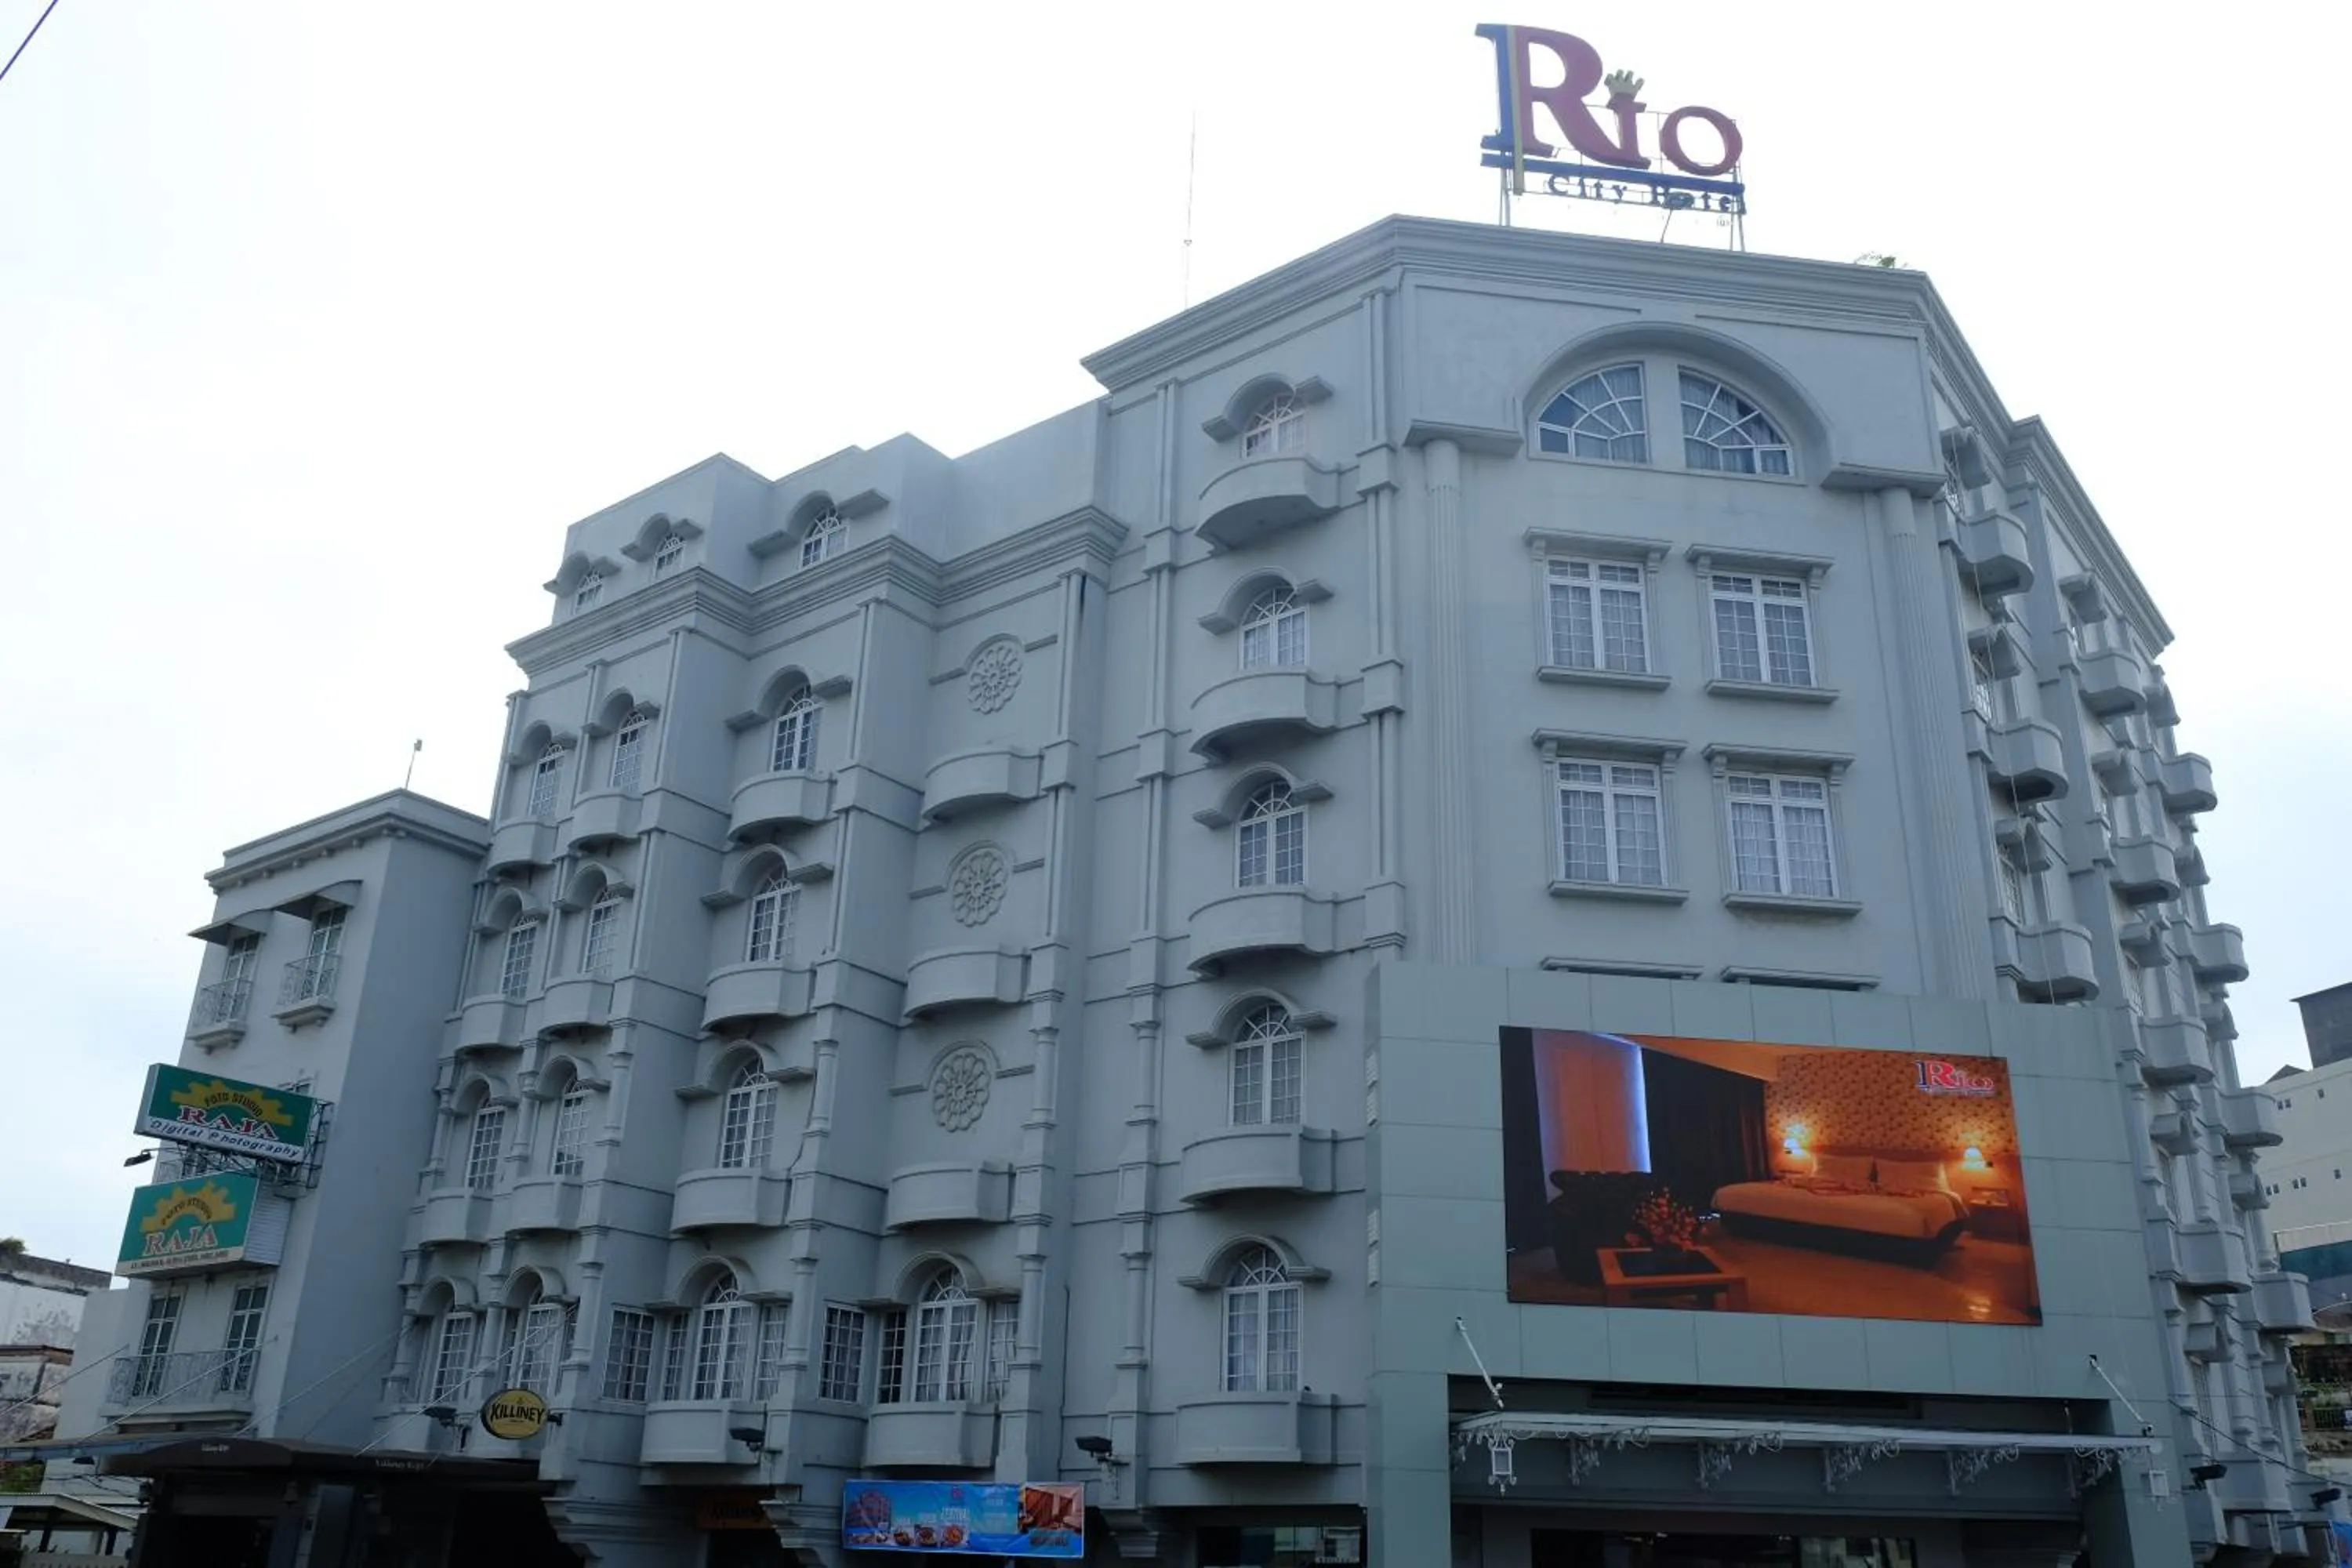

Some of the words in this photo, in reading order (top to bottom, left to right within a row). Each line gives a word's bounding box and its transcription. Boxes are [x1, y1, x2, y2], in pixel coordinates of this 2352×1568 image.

[1475, 24, 1744, 177] Rio
[150, 1118, 203, 1138] Digital
[208, 1132, 300, 1158] Photography
[178, 1105, 279, 1141] RAJA
[143, 1223, 219, 1256] RAJA
[490, 1403, 546, 1425] KILLINEY
